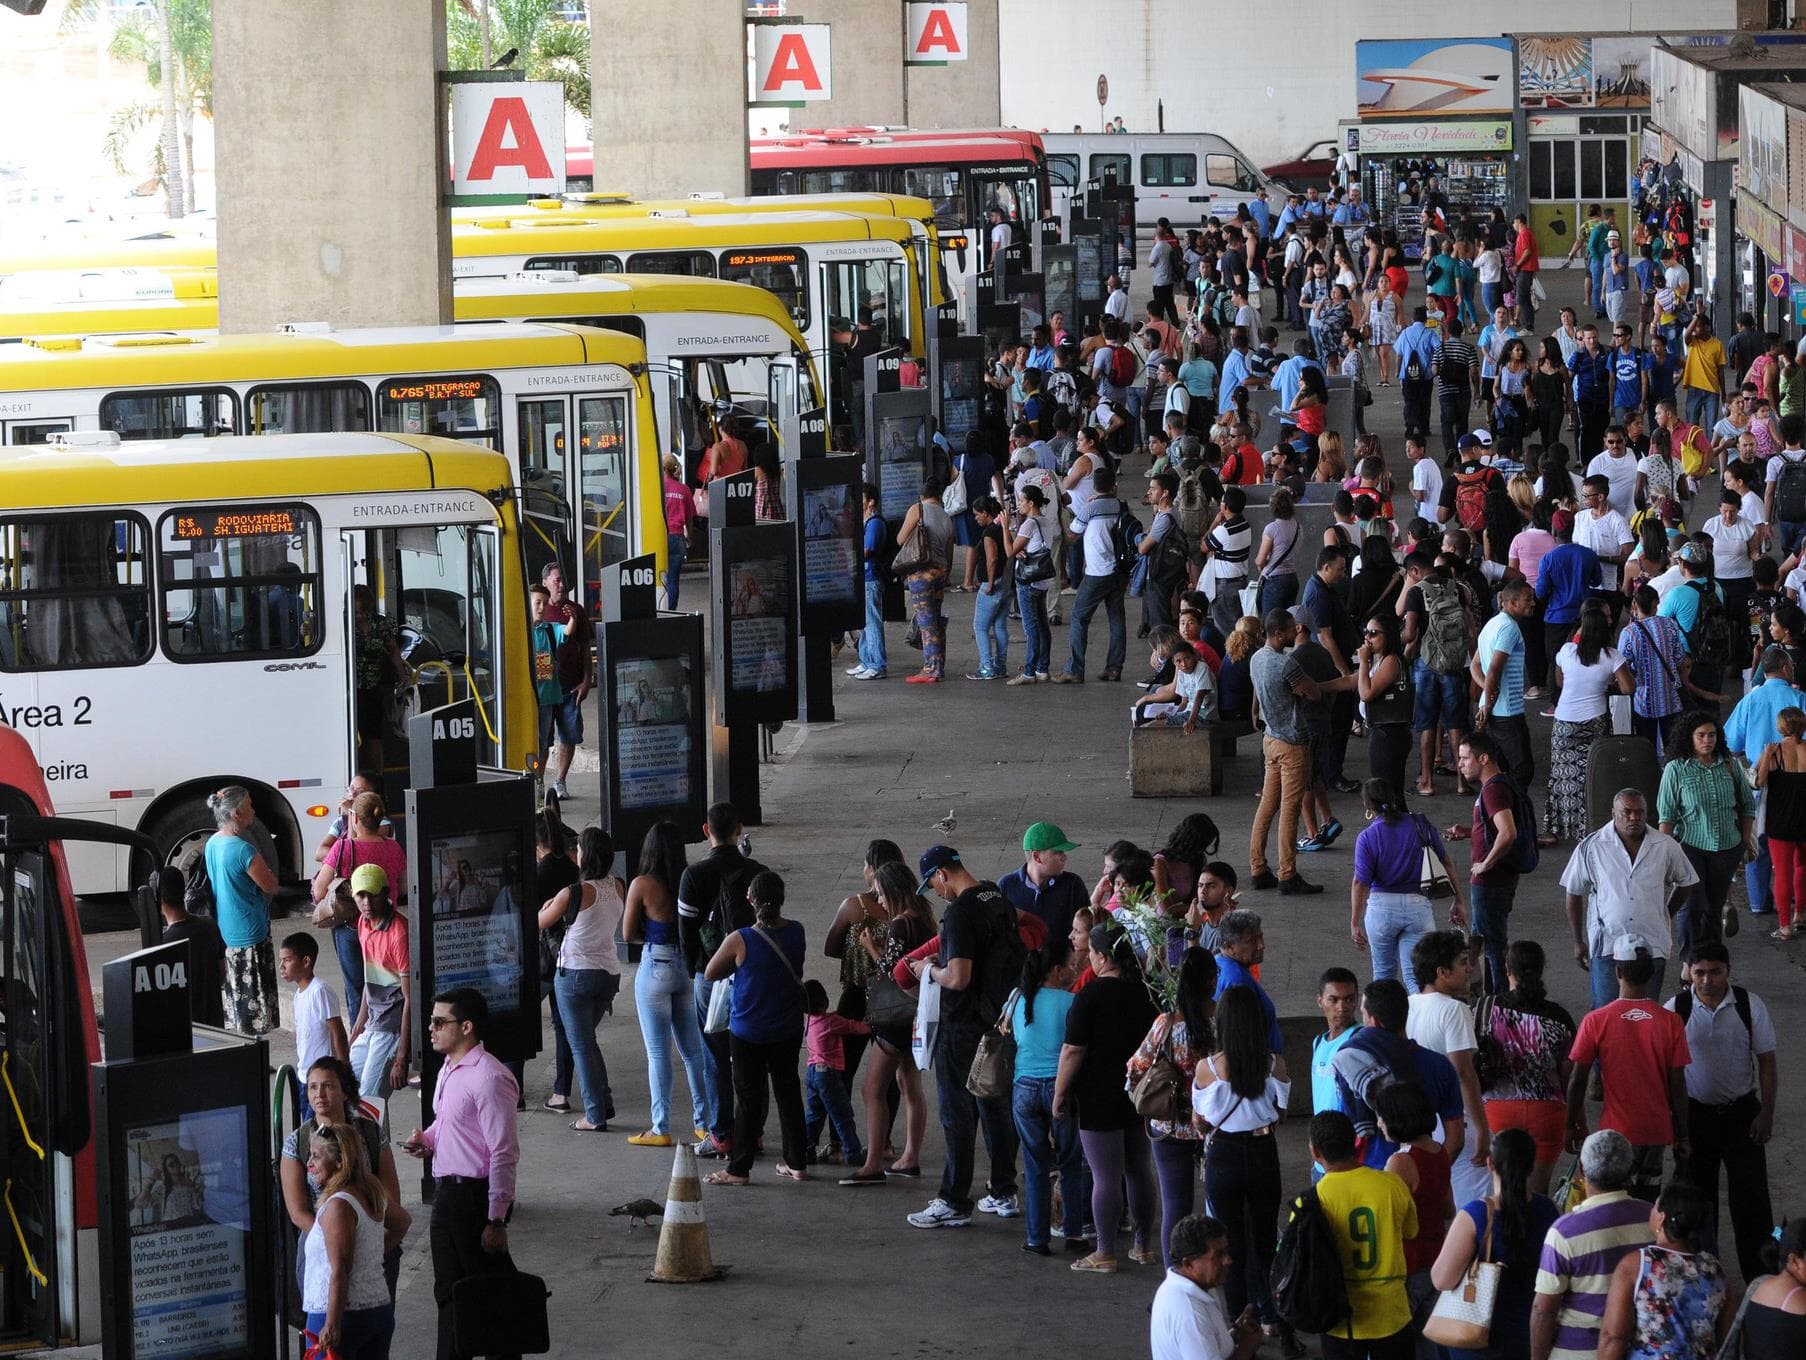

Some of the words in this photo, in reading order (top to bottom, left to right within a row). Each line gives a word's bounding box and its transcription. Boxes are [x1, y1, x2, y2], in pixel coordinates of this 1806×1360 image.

[915, 9, 962, 53] A
[762, 33, 823, 91] A
[466, 96, 555, 181] A
[1088, 182, 1092, 190] A
[1071, 199, 1076, 207] A
[1042, 223, 1047, 231] A
[1047, 222, 1056, 230] 13
[825, 246, 894, 256] ENTRADA-ENTRANCE
[1006, 250, 1012, 259] A
[1012, 250, 1021, 258] 12
[978, 278, 984, 287] A
[984, 277, 993, 287] 11
[939, 309, 945, 319] A
[946, 308, 956, 319] 10
[677, 334, 770, 346] ENTRADA-ENTRANCE
[878, 359, 885, 370] A
[886, 358, 899, 370] 09
[527, 372, 621, 386] ENTRADA-ENTRANCE
[389, 387, 424, 399] 0.765
[459, 389, 477, 398] SUL
[800, 420, 809, 433] A
[810, 418, 824, 432] 08
[727, 483, 736, 498] A
[737, 482, 753, 497] 07
[353, 501, 476, 517] ENTRADA-ENTRANCE
[178, 518, 194, 528] R$
[218, 513, 290, 527] RODOVIARIA
[620, 569, 632, 586] A
[633, 568, 654, 586] 06
[73, 695, 93, 726] 2
[433, 719, 446, 740] A
[449, 717, 475, 739] 05
[134, 966, 152, 993] A
[154, 962, 188, 990] 04
[133, 1240, 156, 1250] Após
[160, 1236, 168, 1246] 13
[171, 1233, 194, 1244] horas
[1348, 1206, 1378, 1271] 9
[134, 1260, 186, 1276] reconhecem
[188, 1258, 203, 1268] que
[170, 1274, 182, 1284] na
[230, 1264, 241, 1272] de
[136, 1290, 178, 1302] conversas
